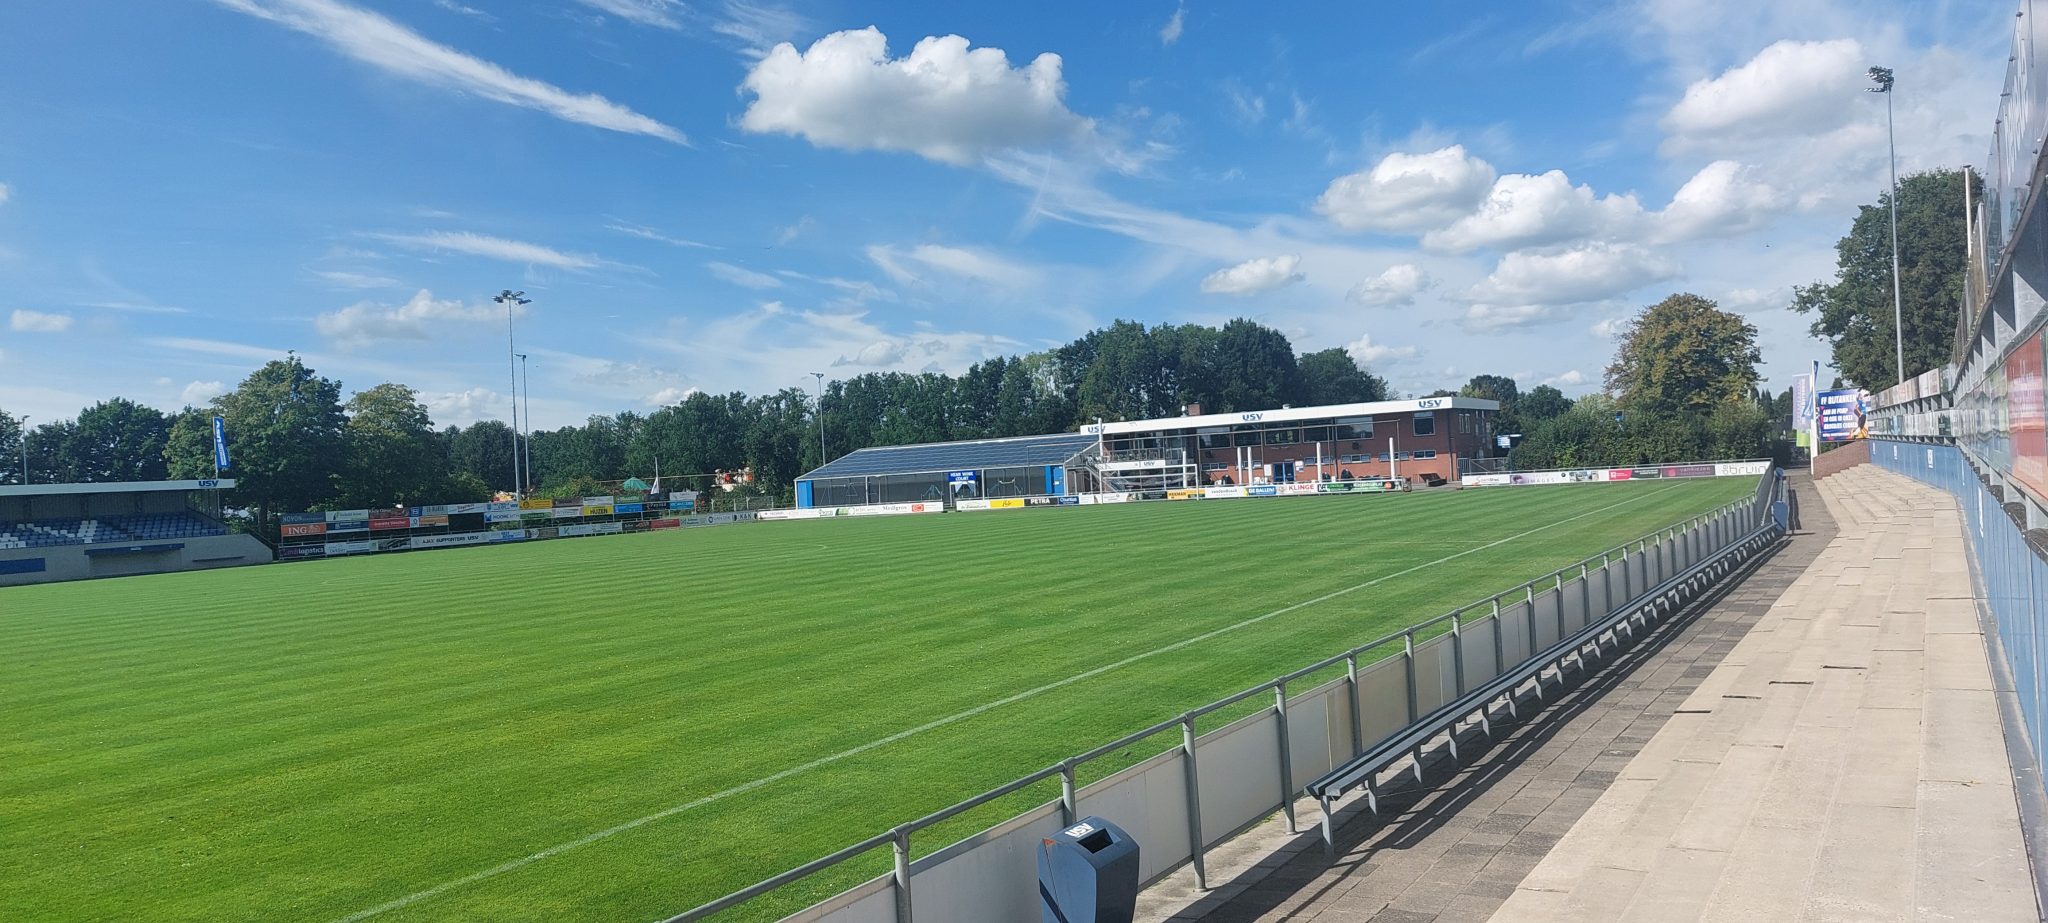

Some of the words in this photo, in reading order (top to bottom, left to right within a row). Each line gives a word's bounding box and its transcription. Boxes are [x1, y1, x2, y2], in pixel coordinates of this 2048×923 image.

[1419, 399, 1442, 408] USV
[1242, 413, 1263, 421] USV
[1289, 483, 1314, 491] KLINGE
[1030, 497, 1050, 505] PETRA
[288, 526, 307, 535] ING
[1064, 822, 1095, 838] USV
